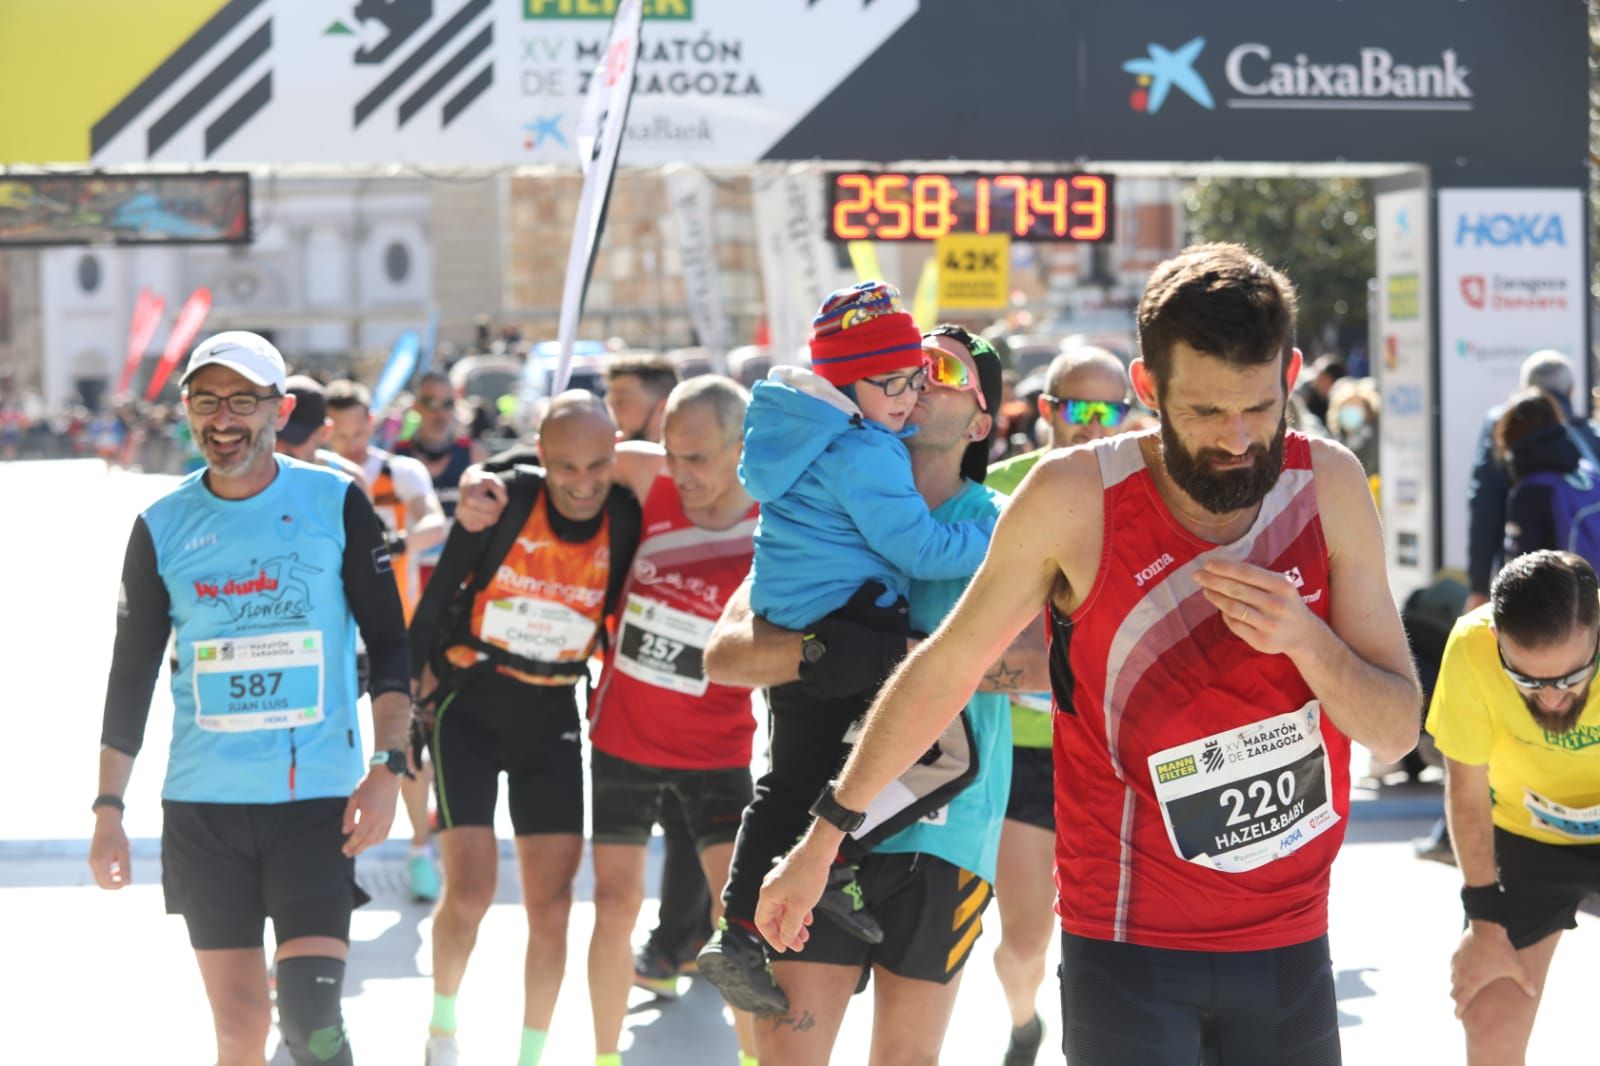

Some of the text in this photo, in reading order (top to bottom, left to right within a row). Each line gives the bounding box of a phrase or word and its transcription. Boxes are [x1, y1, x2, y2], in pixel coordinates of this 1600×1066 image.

[520, 38, 563, 62] XV
[521, 71, 564, 95] DE
[1225, 43, 1473, 98] CaixaBank
[1455, 213, 1567, 247] HOKA
[640, 633, 685, 661] 257
[229, 672, 283, 699] 587
[228, 699, 289, 713] JUAN LUIS
[1243, 723, 1297, 746] MARATÓN
[1247, 732, 1304, 758] ZARAGOZA
[1158, 756, 1193, 774] MANN
[1160, 765, 1196, 782] FILTER
[1219, 770, 1296, 827] 220
[1215, 800, 1305, 850] HAZEL&BABY
